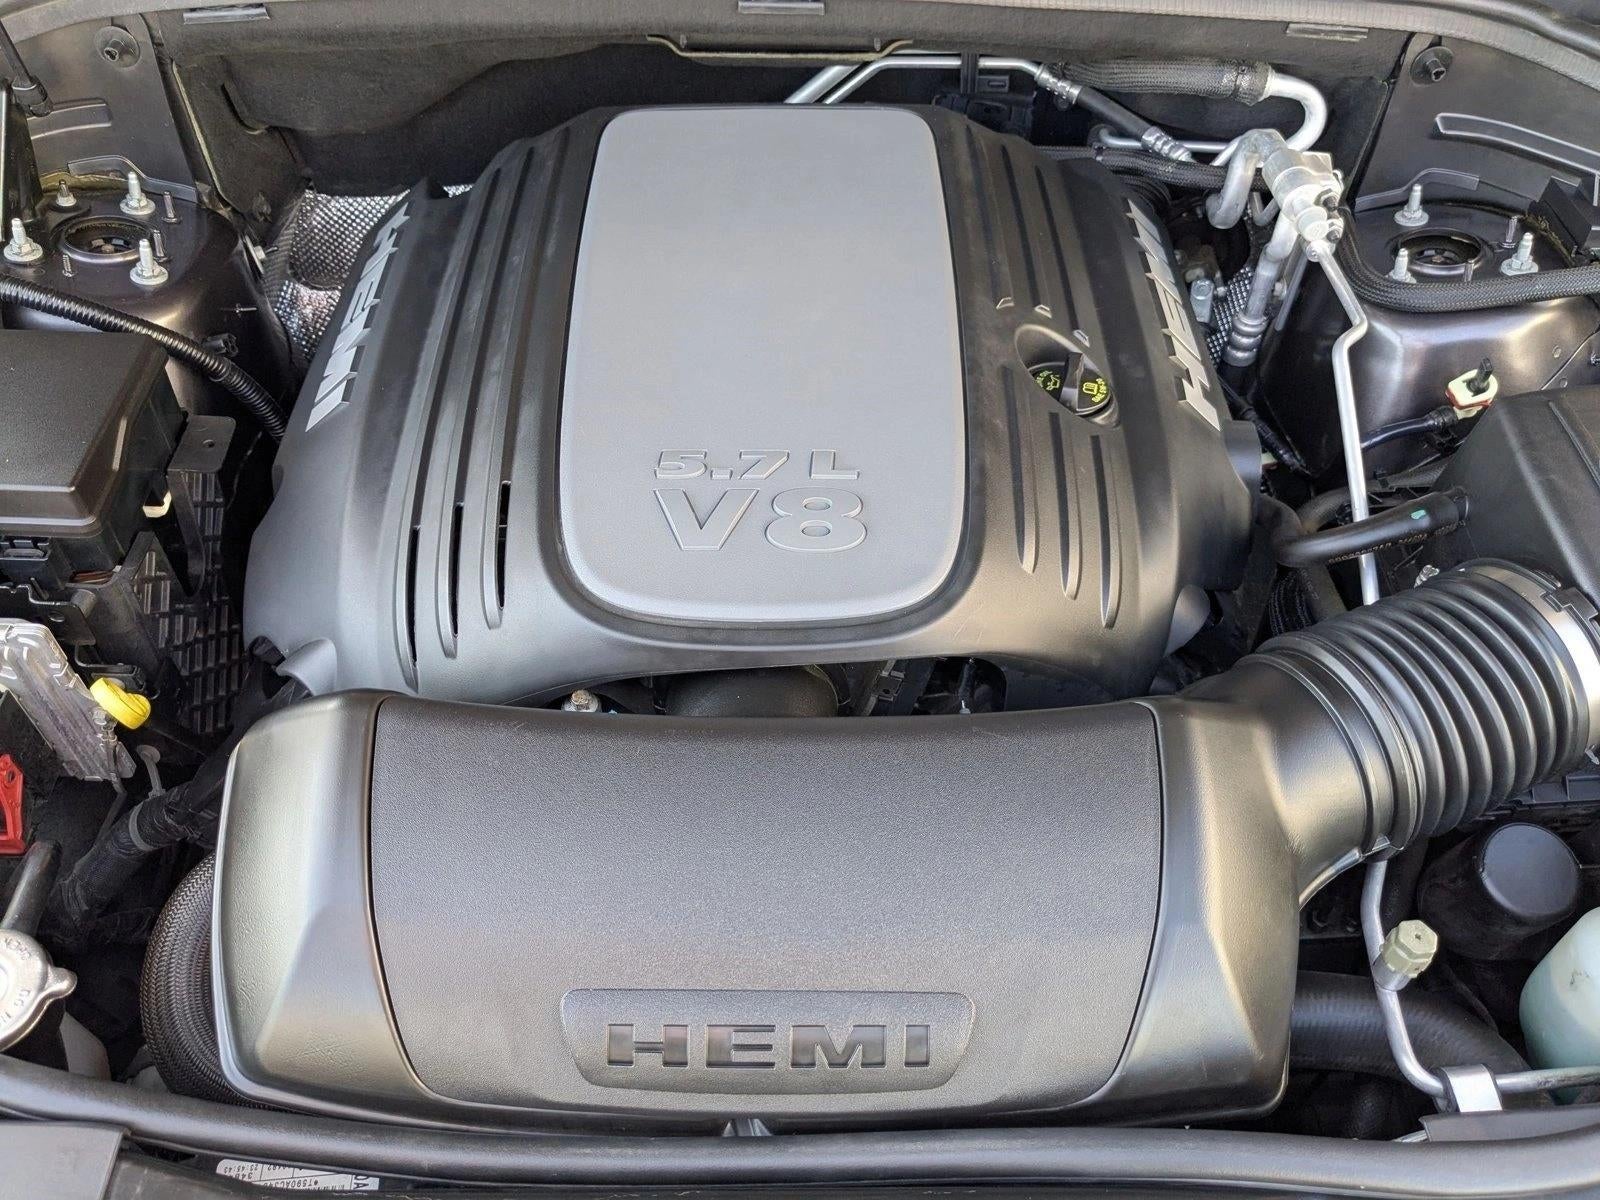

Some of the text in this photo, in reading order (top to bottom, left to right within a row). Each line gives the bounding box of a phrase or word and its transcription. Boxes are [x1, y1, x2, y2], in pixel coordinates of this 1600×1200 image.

[306, 202, 410, 432] HEMI
[1126, 199, 1221, 432] HEMI
[652, 486, 868, 552] V8
[607, 1023, 931, 1070] HEMI
